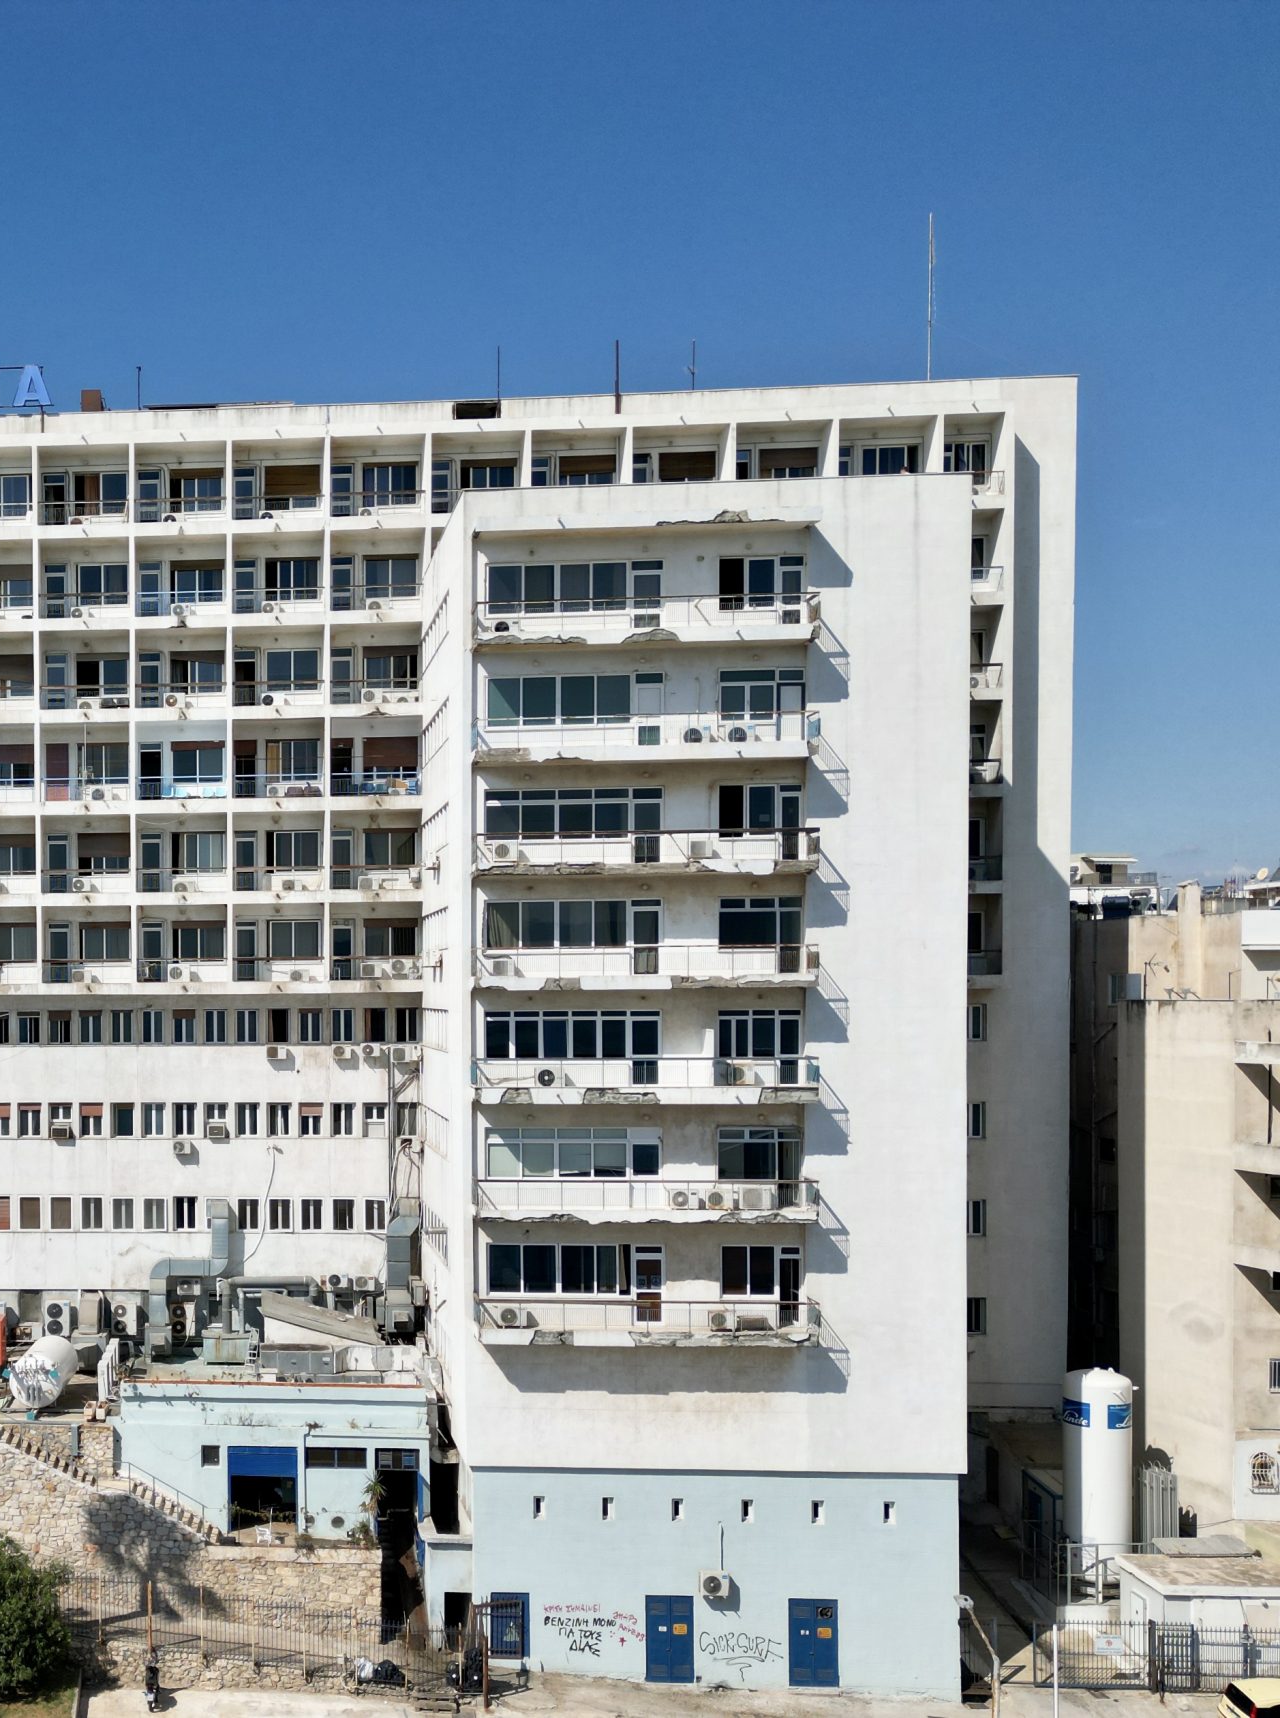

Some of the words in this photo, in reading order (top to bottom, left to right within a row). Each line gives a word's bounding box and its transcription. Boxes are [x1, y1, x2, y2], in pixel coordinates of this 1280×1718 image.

[544, 1616, 589, 1627] ΒΕΝΖΙΝΗ
[592, 1617, 617, 1627] ΜΟΝΟ
[578, 1629, 602, 1643] ΤΟΥΣ
